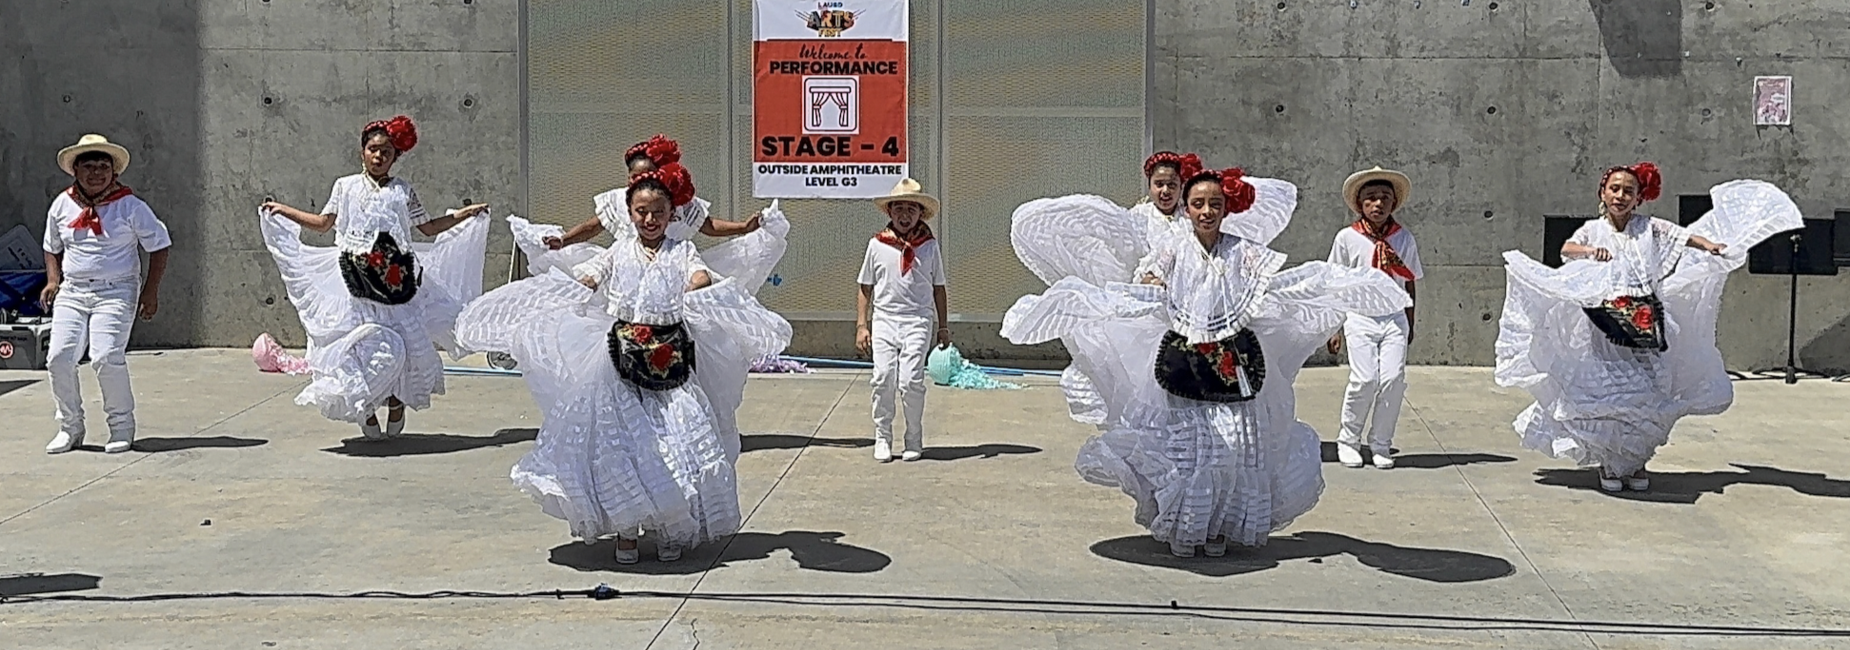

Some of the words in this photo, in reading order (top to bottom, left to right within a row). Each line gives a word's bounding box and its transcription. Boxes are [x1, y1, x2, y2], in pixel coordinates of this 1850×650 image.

[808, 10, 854, 28] ARTS
[818, 28, 842, 37] FEST
[799, 43, 849, 60] Welcome
[855, 42, 867, 60] to
[769, 61, 898, 75] PERFORMANCE
[761, 136, 851, 157] STAGE
[882, 136, 899, 157] 4
[758, 165, 808, 175] OUTSIDE
[810, 165, 902, 175] AMPHITHEATRE
[805, 177, 838, 187] LEVEL
[841, 177, 857, 187] G3
